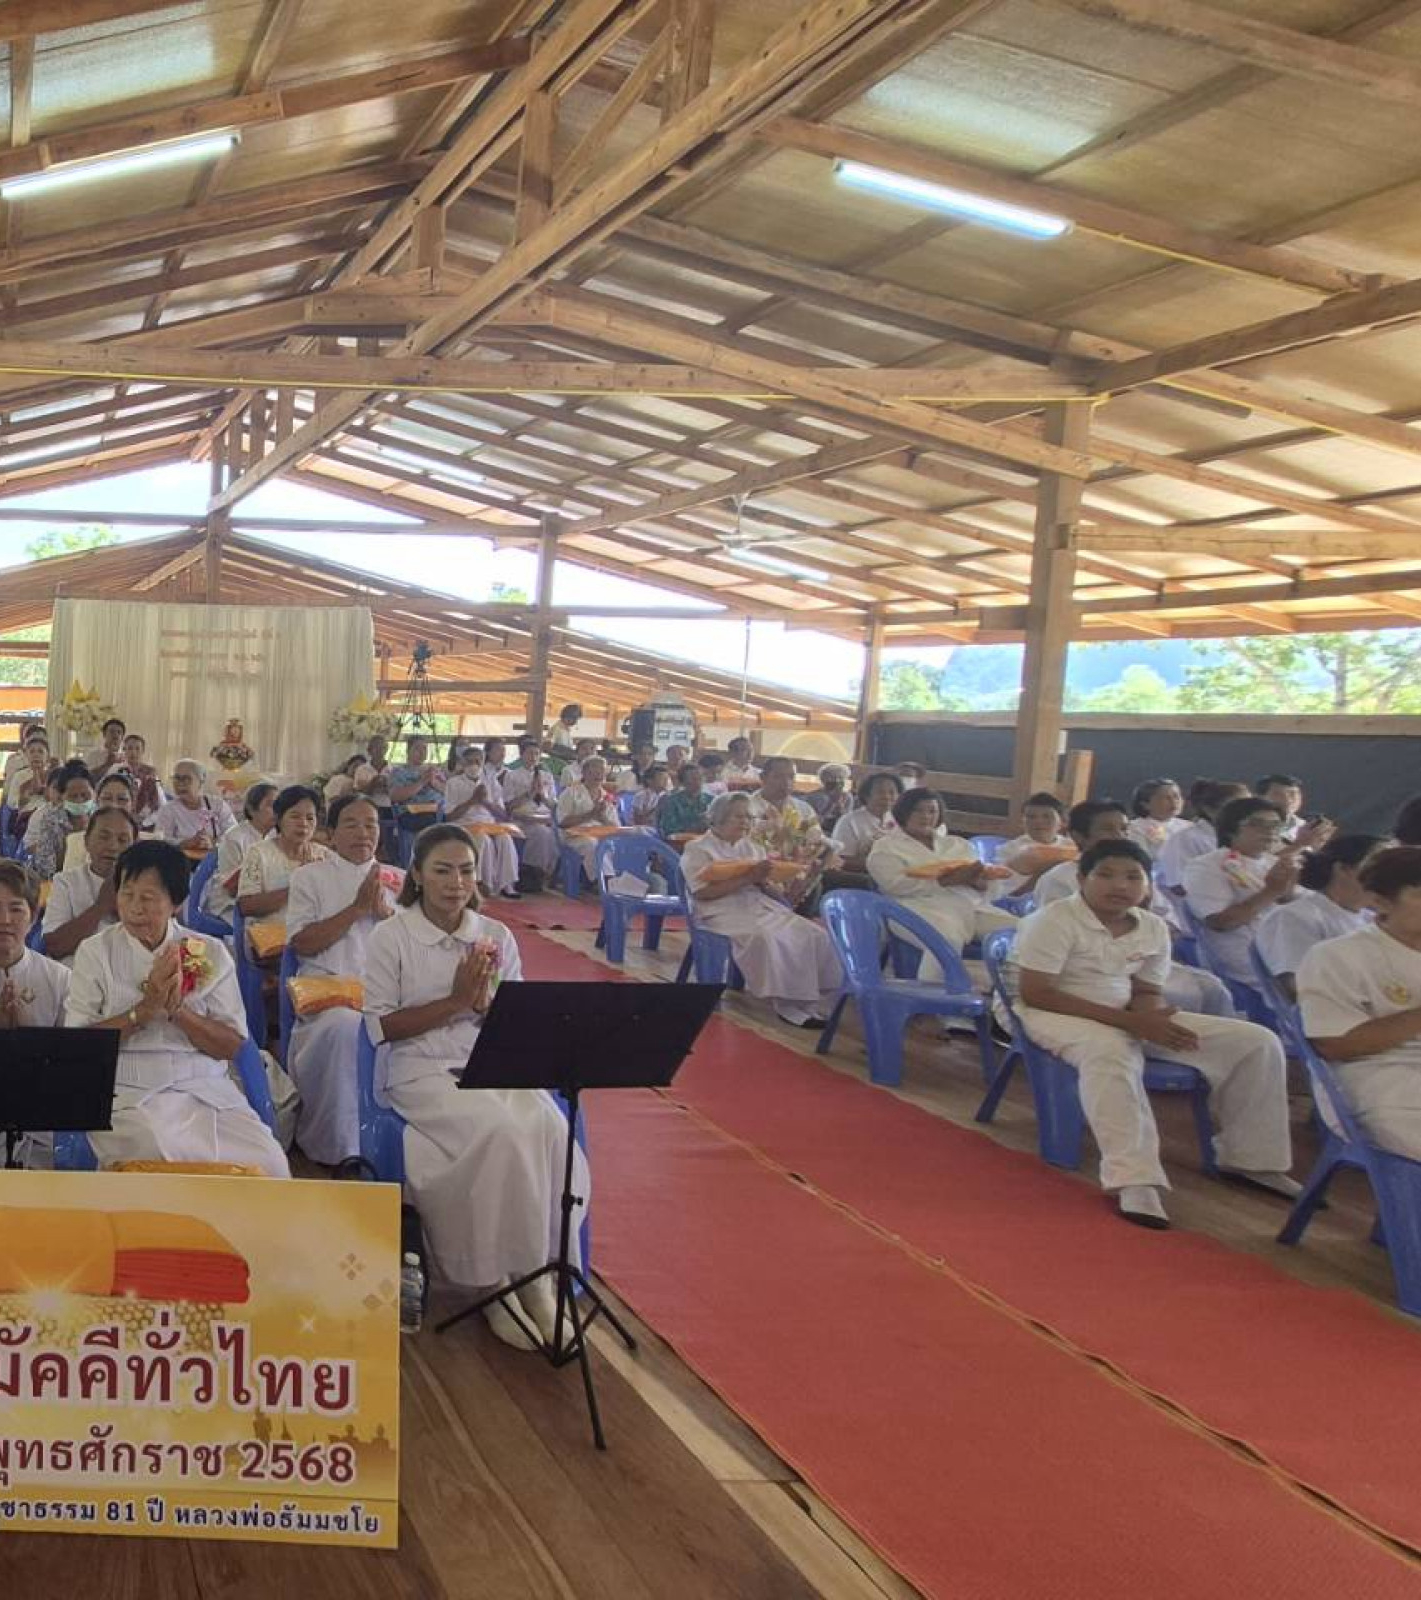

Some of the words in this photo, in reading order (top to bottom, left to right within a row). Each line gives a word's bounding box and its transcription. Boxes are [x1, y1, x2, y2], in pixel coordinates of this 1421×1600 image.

[241, 1441, 355, 1483] 2568
[106, 1501, 135, 1522] 81
[146, 1497, 164, 1523] ปี
